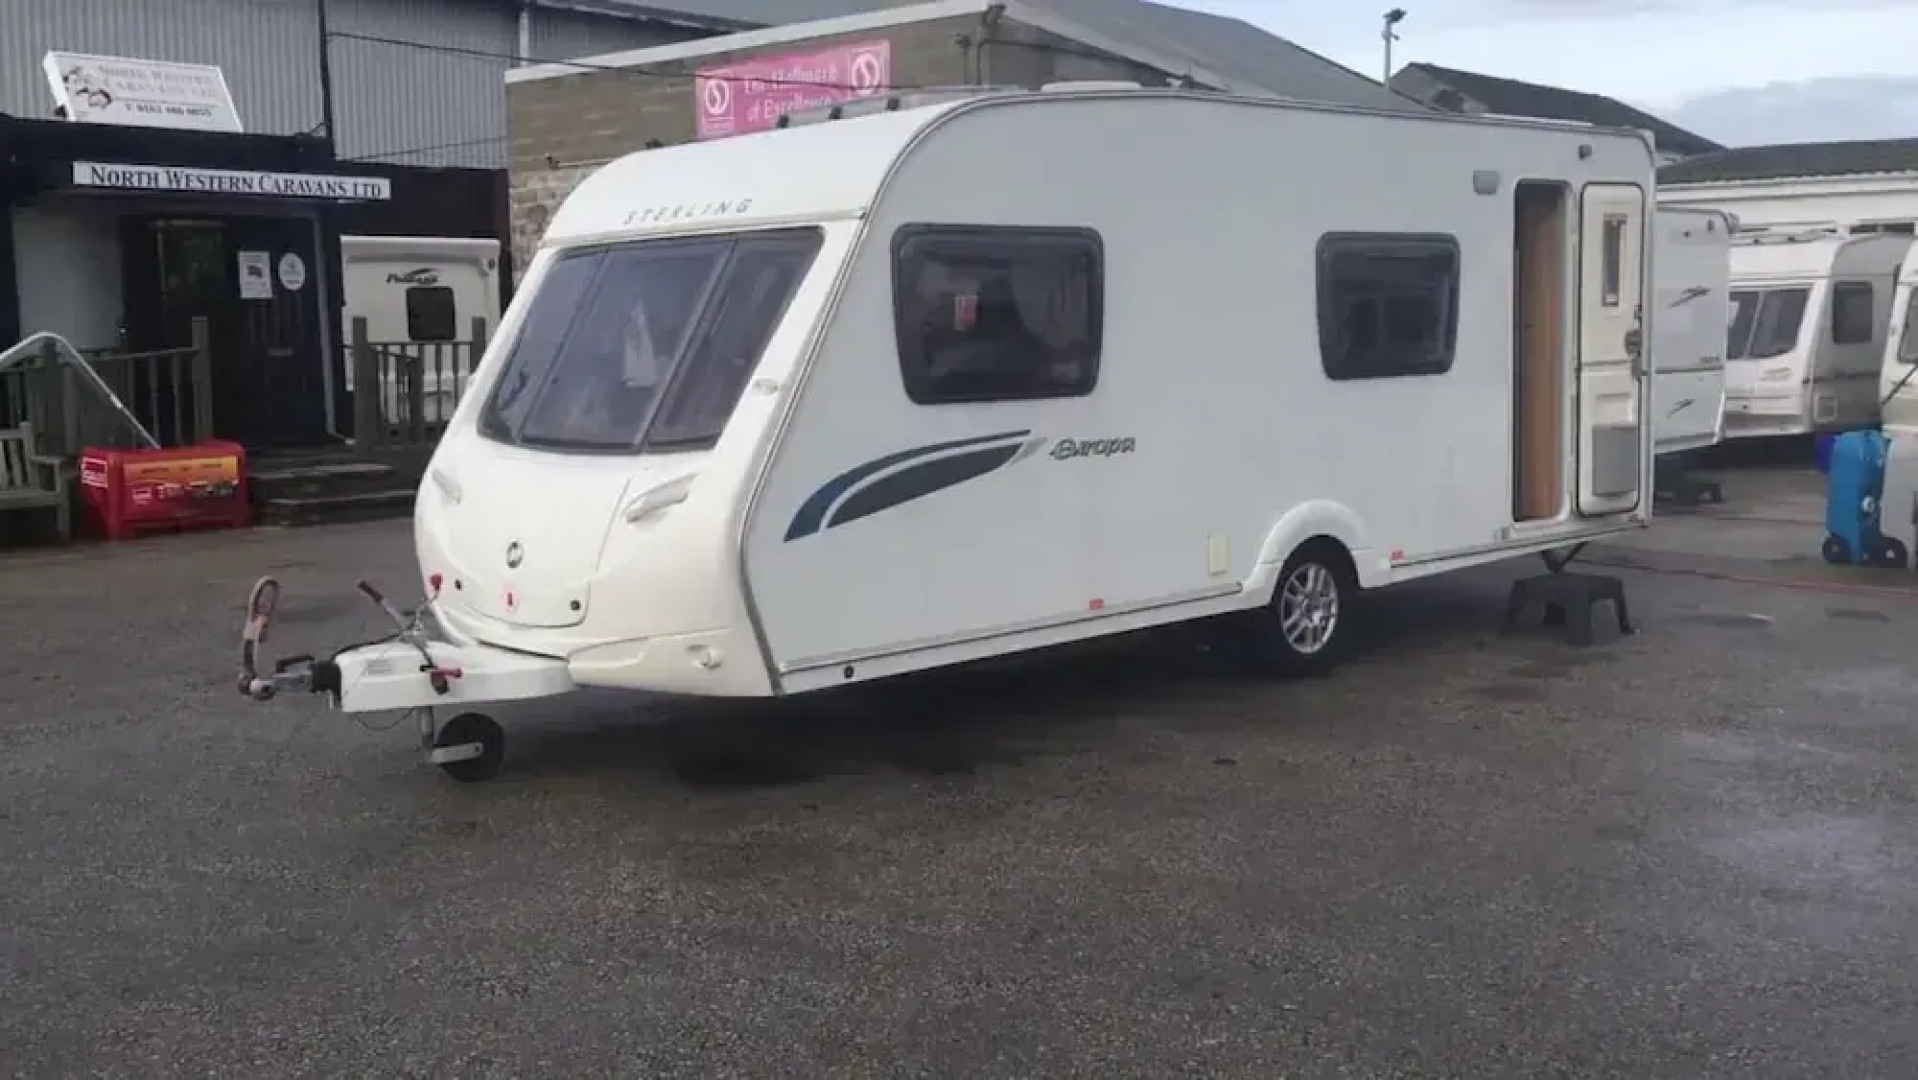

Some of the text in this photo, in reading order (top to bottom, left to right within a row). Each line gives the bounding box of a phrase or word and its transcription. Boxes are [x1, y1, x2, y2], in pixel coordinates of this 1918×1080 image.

[92, 166, 382, 197] NORTH WESTERN CARAVANS LTD
[622, 198, 752, 225] STERLING
[1050, 437, 1136, 460] Europa
